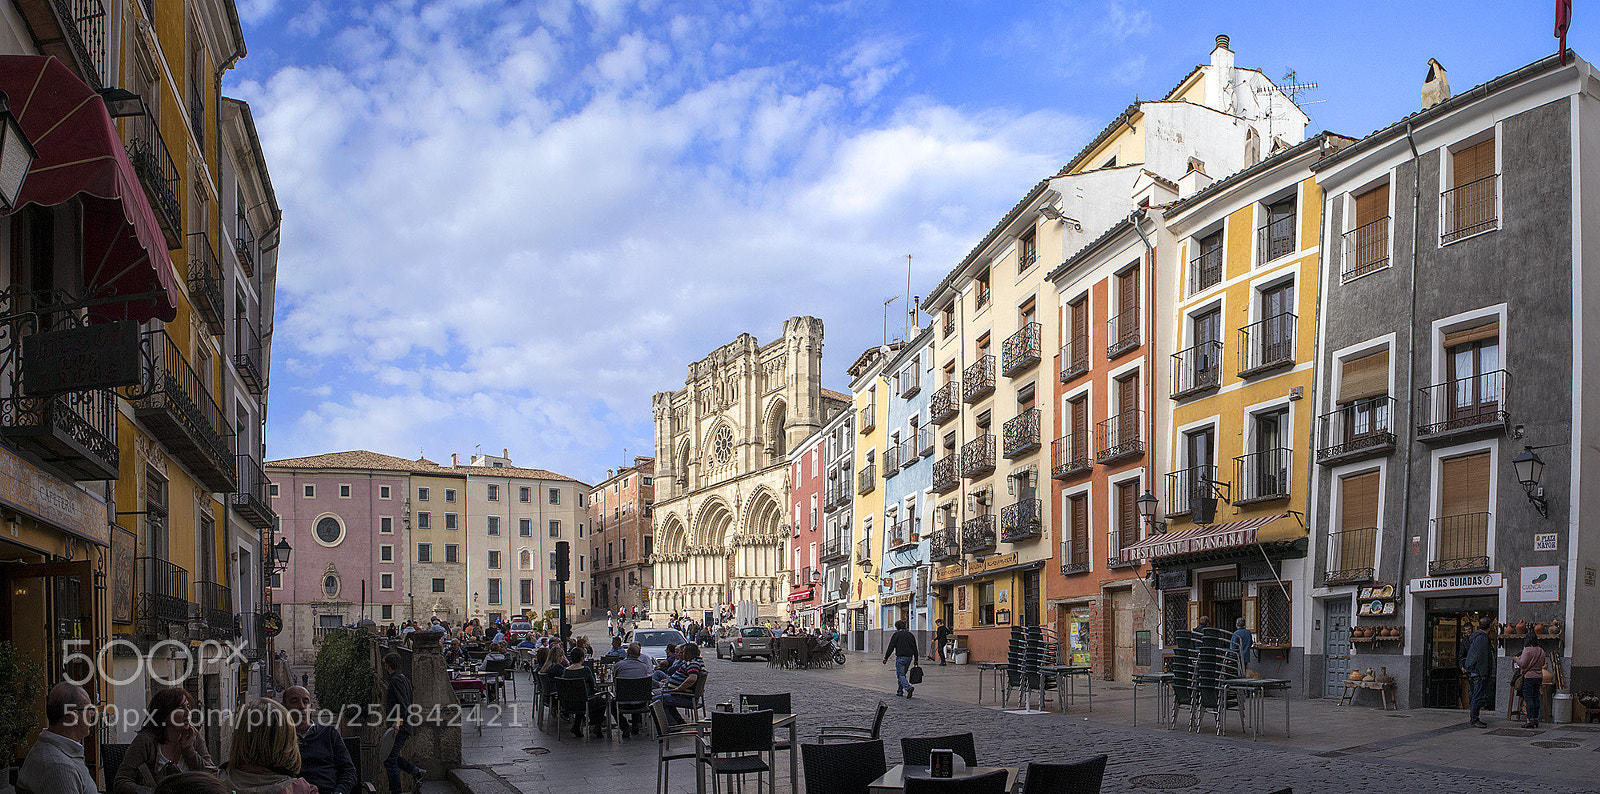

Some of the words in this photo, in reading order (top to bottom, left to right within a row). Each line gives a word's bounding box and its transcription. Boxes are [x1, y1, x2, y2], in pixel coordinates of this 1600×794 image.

[1195, 531, 1242, 551] MANGANA
[1537, 541, 1556, 549] MAYOR
[1419, 578, 1448, 589] VISITAS
[1449, 576, 1483, 587] GUIADAS
